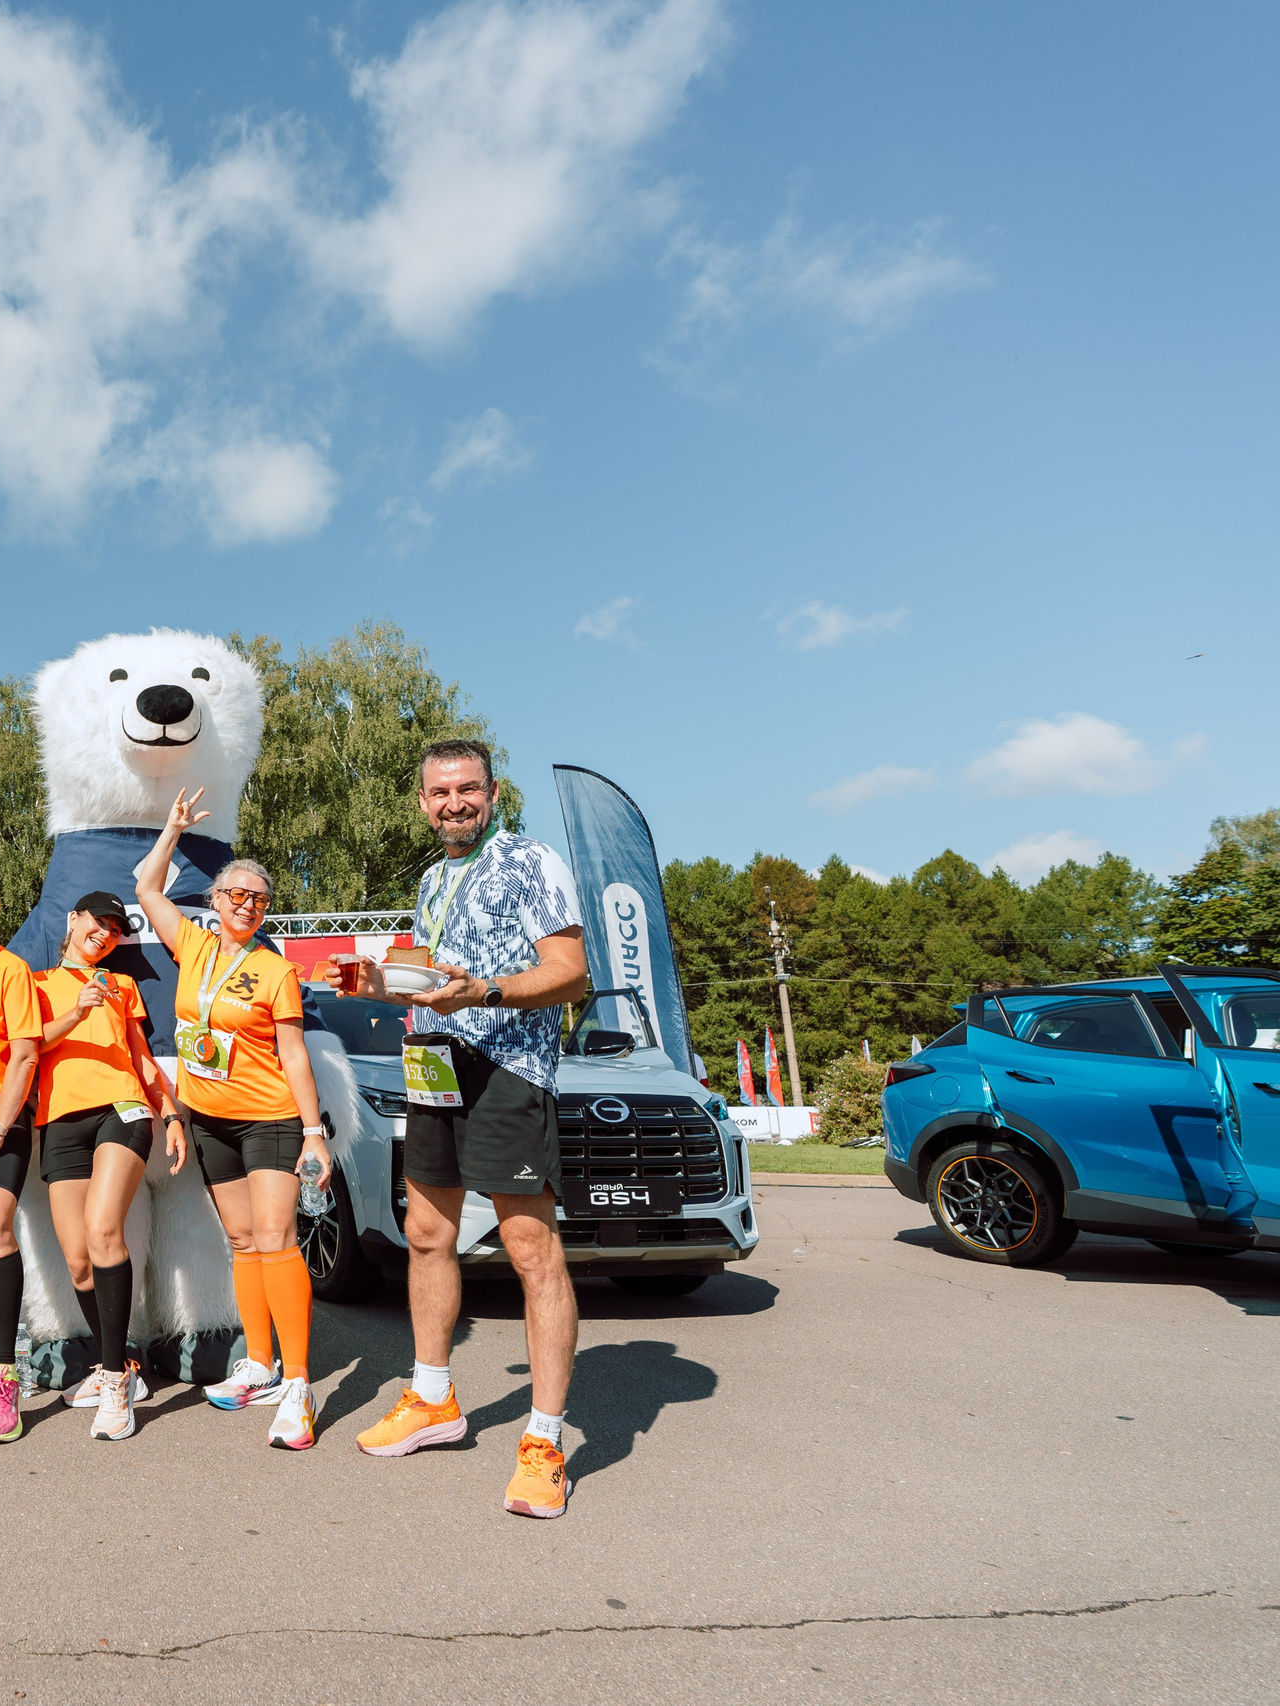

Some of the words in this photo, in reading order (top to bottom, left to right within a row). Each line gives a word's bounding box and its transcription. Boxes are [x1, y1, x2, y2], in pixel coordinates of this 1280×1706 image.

[220, 994, 253, 1012] LIPETSK
[409, 1064, 438, 1081] 5236
[589, 1183, 623, 1191] НОВЫЙ
[590, 1191, 650, 1206] GS4
